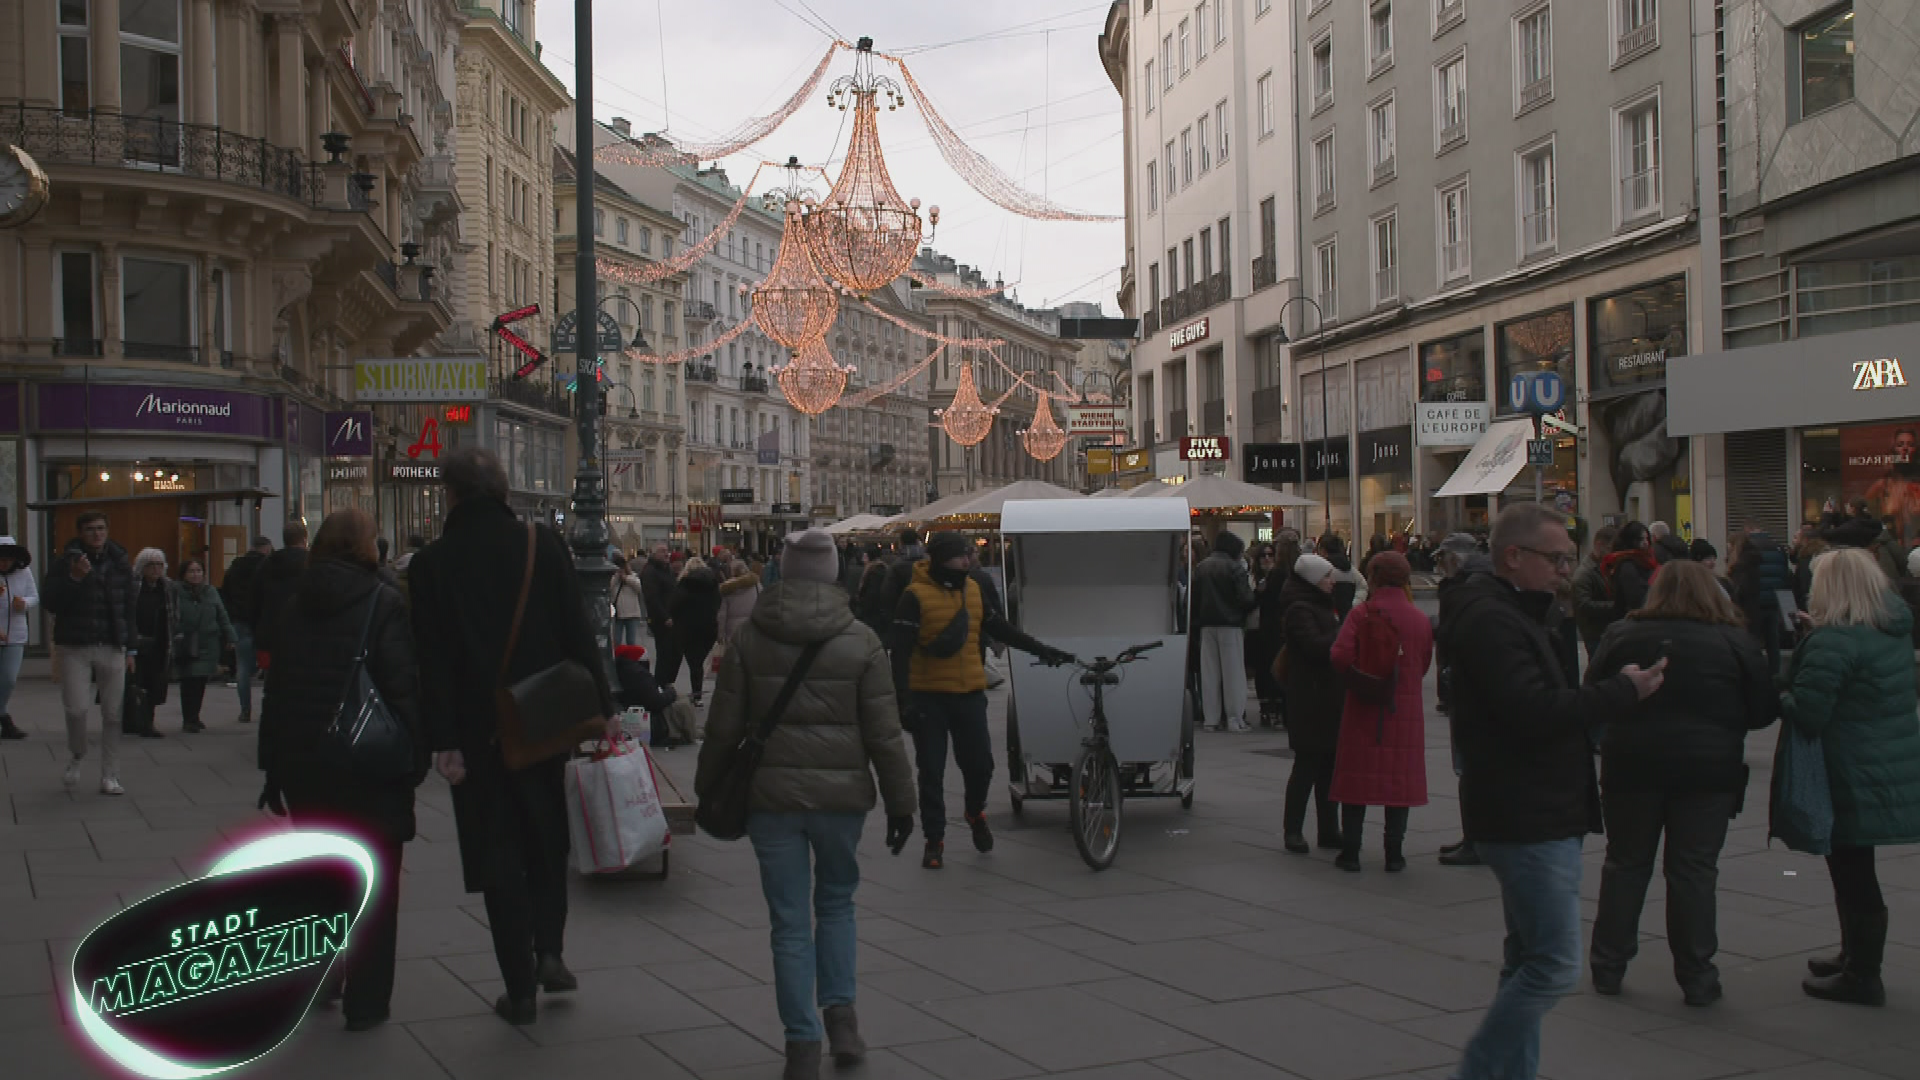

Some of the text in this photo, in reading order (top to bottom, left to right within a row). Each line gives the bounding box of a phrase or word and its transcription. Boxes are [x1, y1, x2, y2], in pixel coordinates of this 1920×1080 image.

[1170, 320, 1206, 349] FIVE GUYS
[1619, 351, 1665, 370] RESTAURANT
[363, 362, 477, 391] STURMAYR
[1852, 357, 1907, 390] ZARA
[1511, 381, 1526, 408] U
[1535, 379, 1560, 407] U
[136, 393, 231, 417] Marionnaud
[1080, 412, 1114, 420] WIENER
[1464, 409, 1480, 420] DE
[1422, 422, 1487, 433] L'EUROPE
[1191, 438, 1218, 448] FIVE
[1529, 441, 1551, 453] WC
[1188, 448, 1222, 458] GUYS
[1373, 443, 1399, 464] Jones
[1252, 455, 1296, 471] Jones
[392, 466, 439, 478] APOTHEKE
[1258, 528, 1273, 542] FIVE
